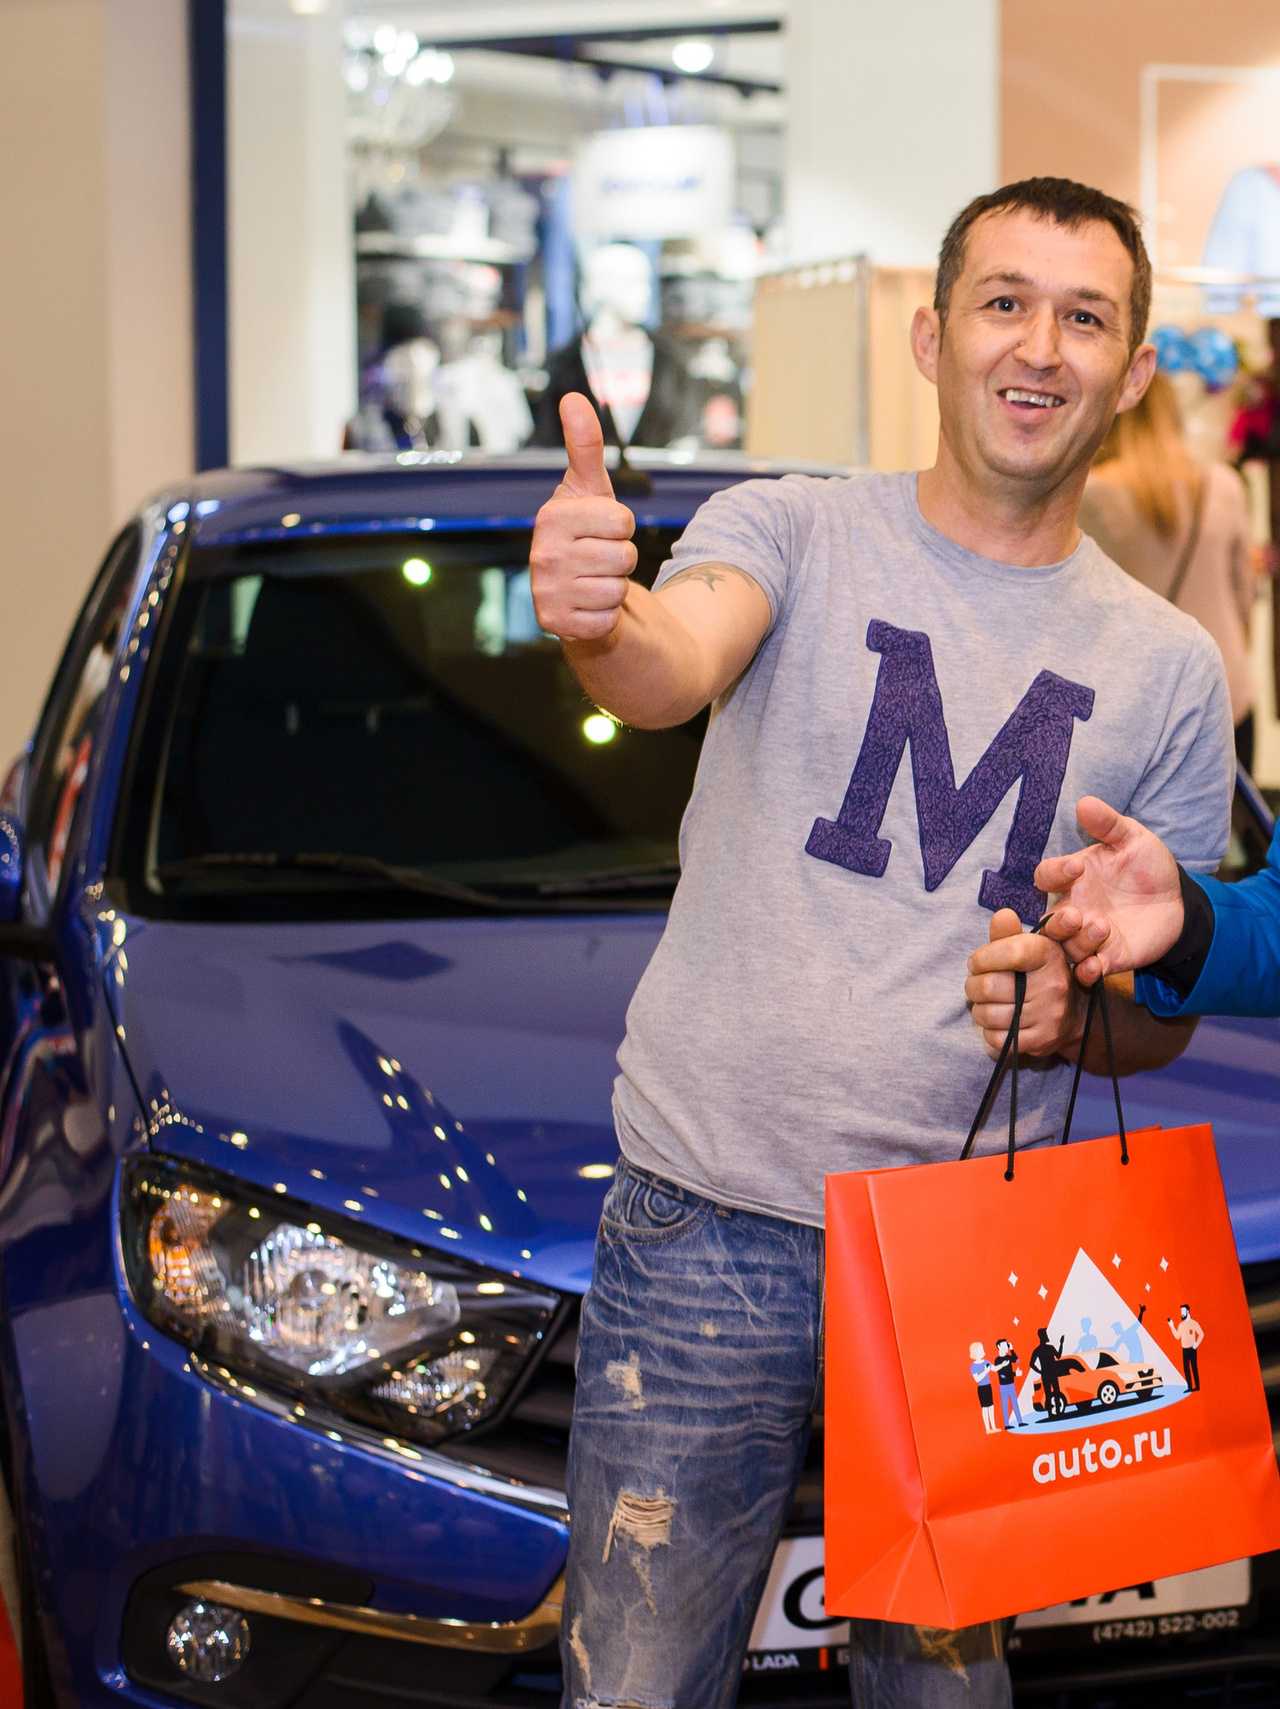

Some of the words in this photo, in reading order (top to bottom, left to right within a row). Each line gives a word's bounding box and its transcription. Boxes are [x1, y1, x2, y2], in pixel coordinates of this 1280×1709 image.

[805, 618, 1095, 926] M
[1033, 1428, 1171, 1484] auto.ru
[1093, 1620, 1155, 1643] (4742)
[1158, 1609, 1239, 1635] 522-002
[752, 1653, 800, 1671] LADA
